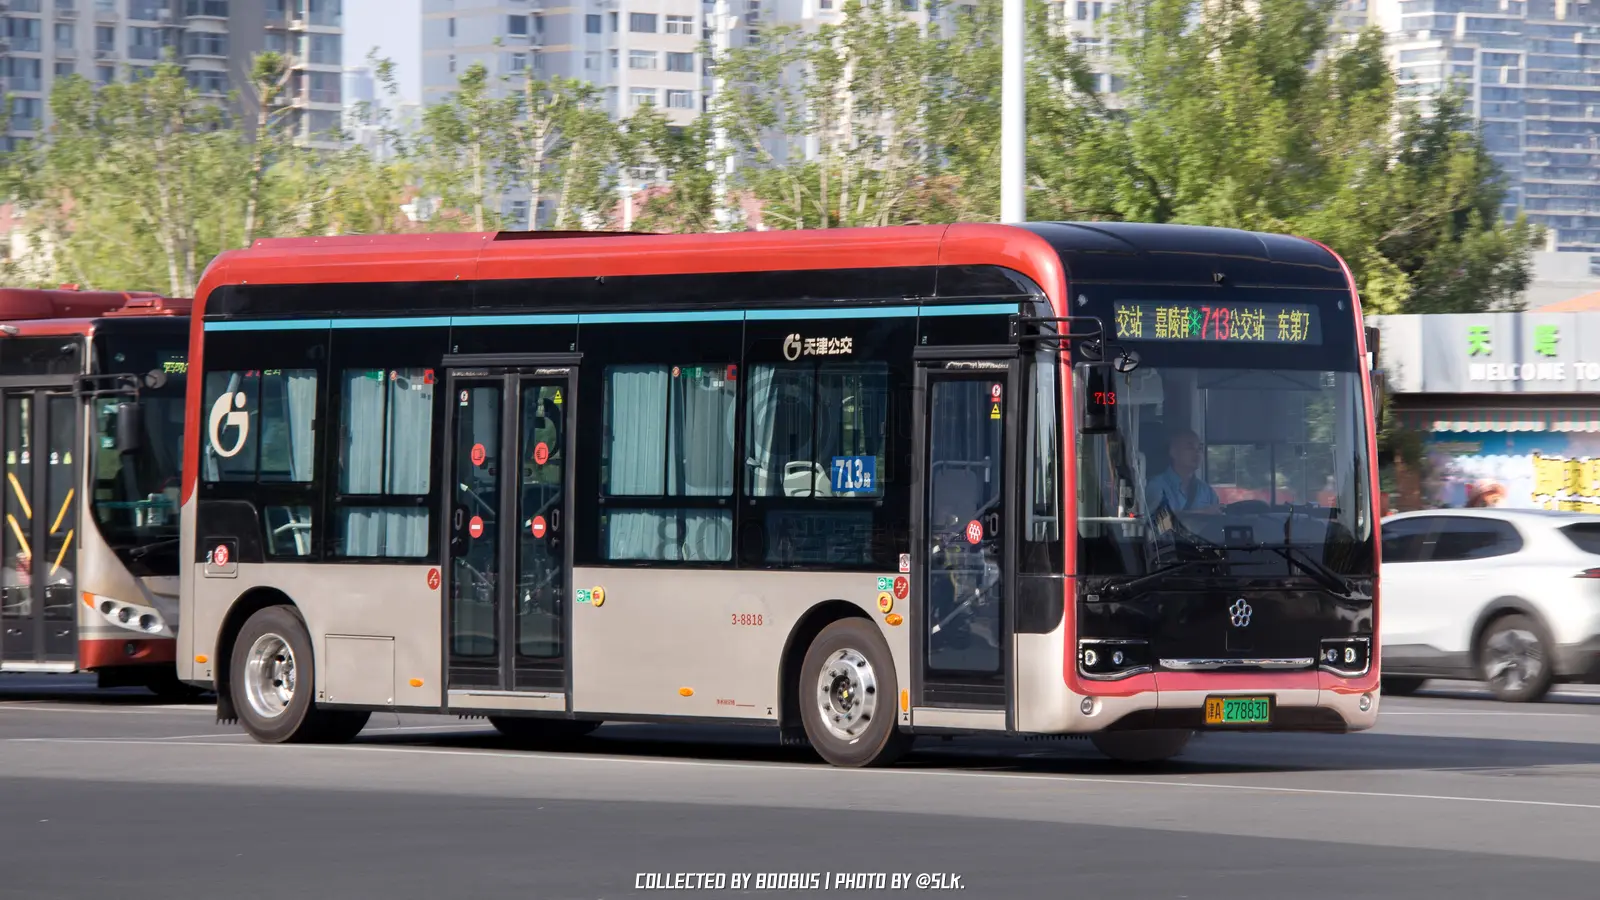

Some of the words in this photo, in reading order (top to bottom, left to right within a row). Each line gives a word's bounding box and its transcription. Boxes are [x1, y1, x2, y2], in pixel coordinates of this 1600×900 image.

[1201, 307, 1229, 340] 713
[804, 336, 853, 355] 天津公交
[1469, 363, 1566, 381] WELCOME
[1094, 392, 1115, 405] 713
[731, 613, 763, 626] 3-8818
[1226, 701, 1268, 720] 27883D
